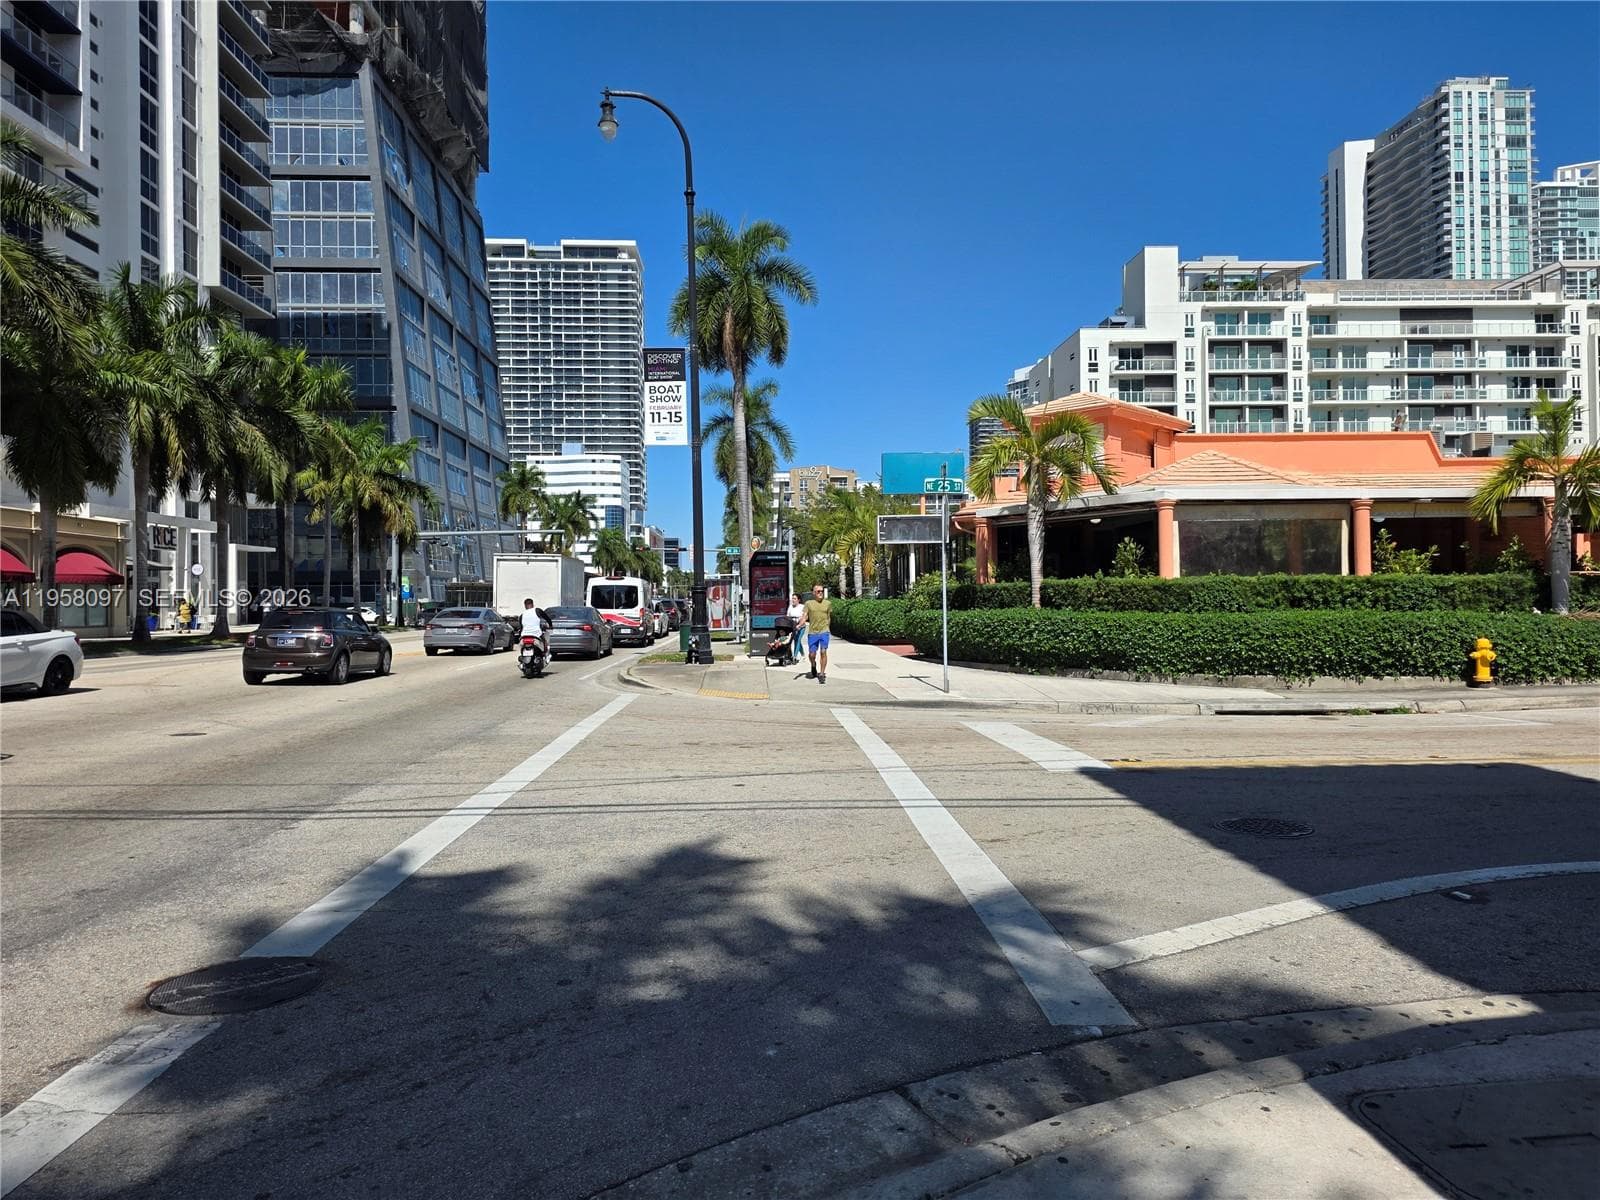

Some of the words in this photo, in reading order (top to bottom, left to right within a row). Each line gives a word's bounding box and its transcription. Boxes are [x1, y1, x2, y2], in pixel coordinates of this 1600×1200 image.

[649, 385, 682, 394] BOAT
[649, 394, 682, 403] SHOW
[649, 411, 683, 424] 11-15
[926, 482, 934, 491] NE
[938, 480, 950, 492] 25
